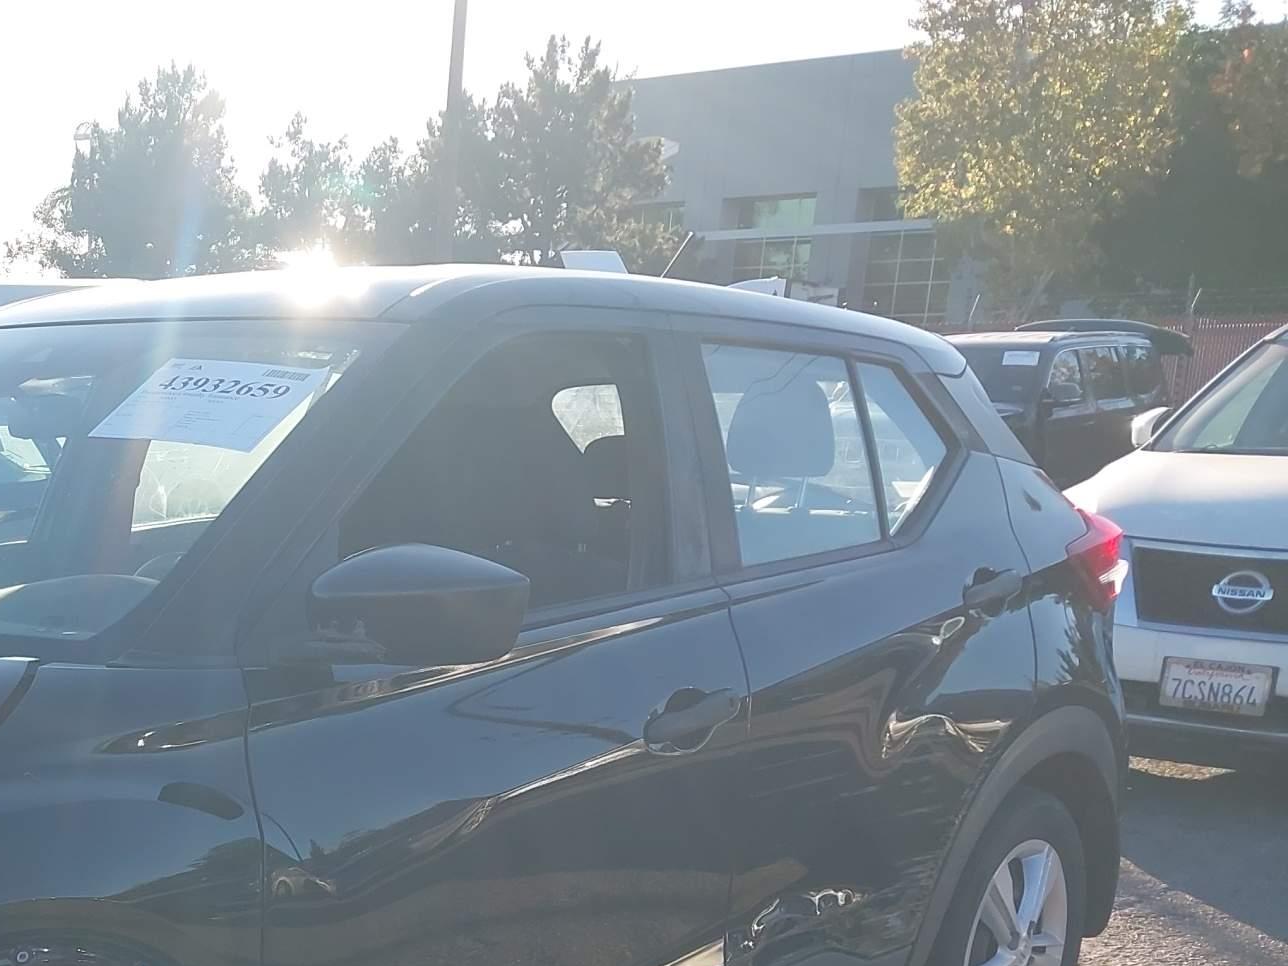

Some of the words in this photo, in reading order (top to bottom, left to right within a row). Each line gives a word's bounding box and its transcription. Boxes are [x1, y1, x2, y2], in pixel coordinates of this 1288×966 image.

[159, 375, 290, 399] 43932659
[1217, 586, 1266, 599] NISSAN
[1172, 678, 1257, 705] 7CSN864
